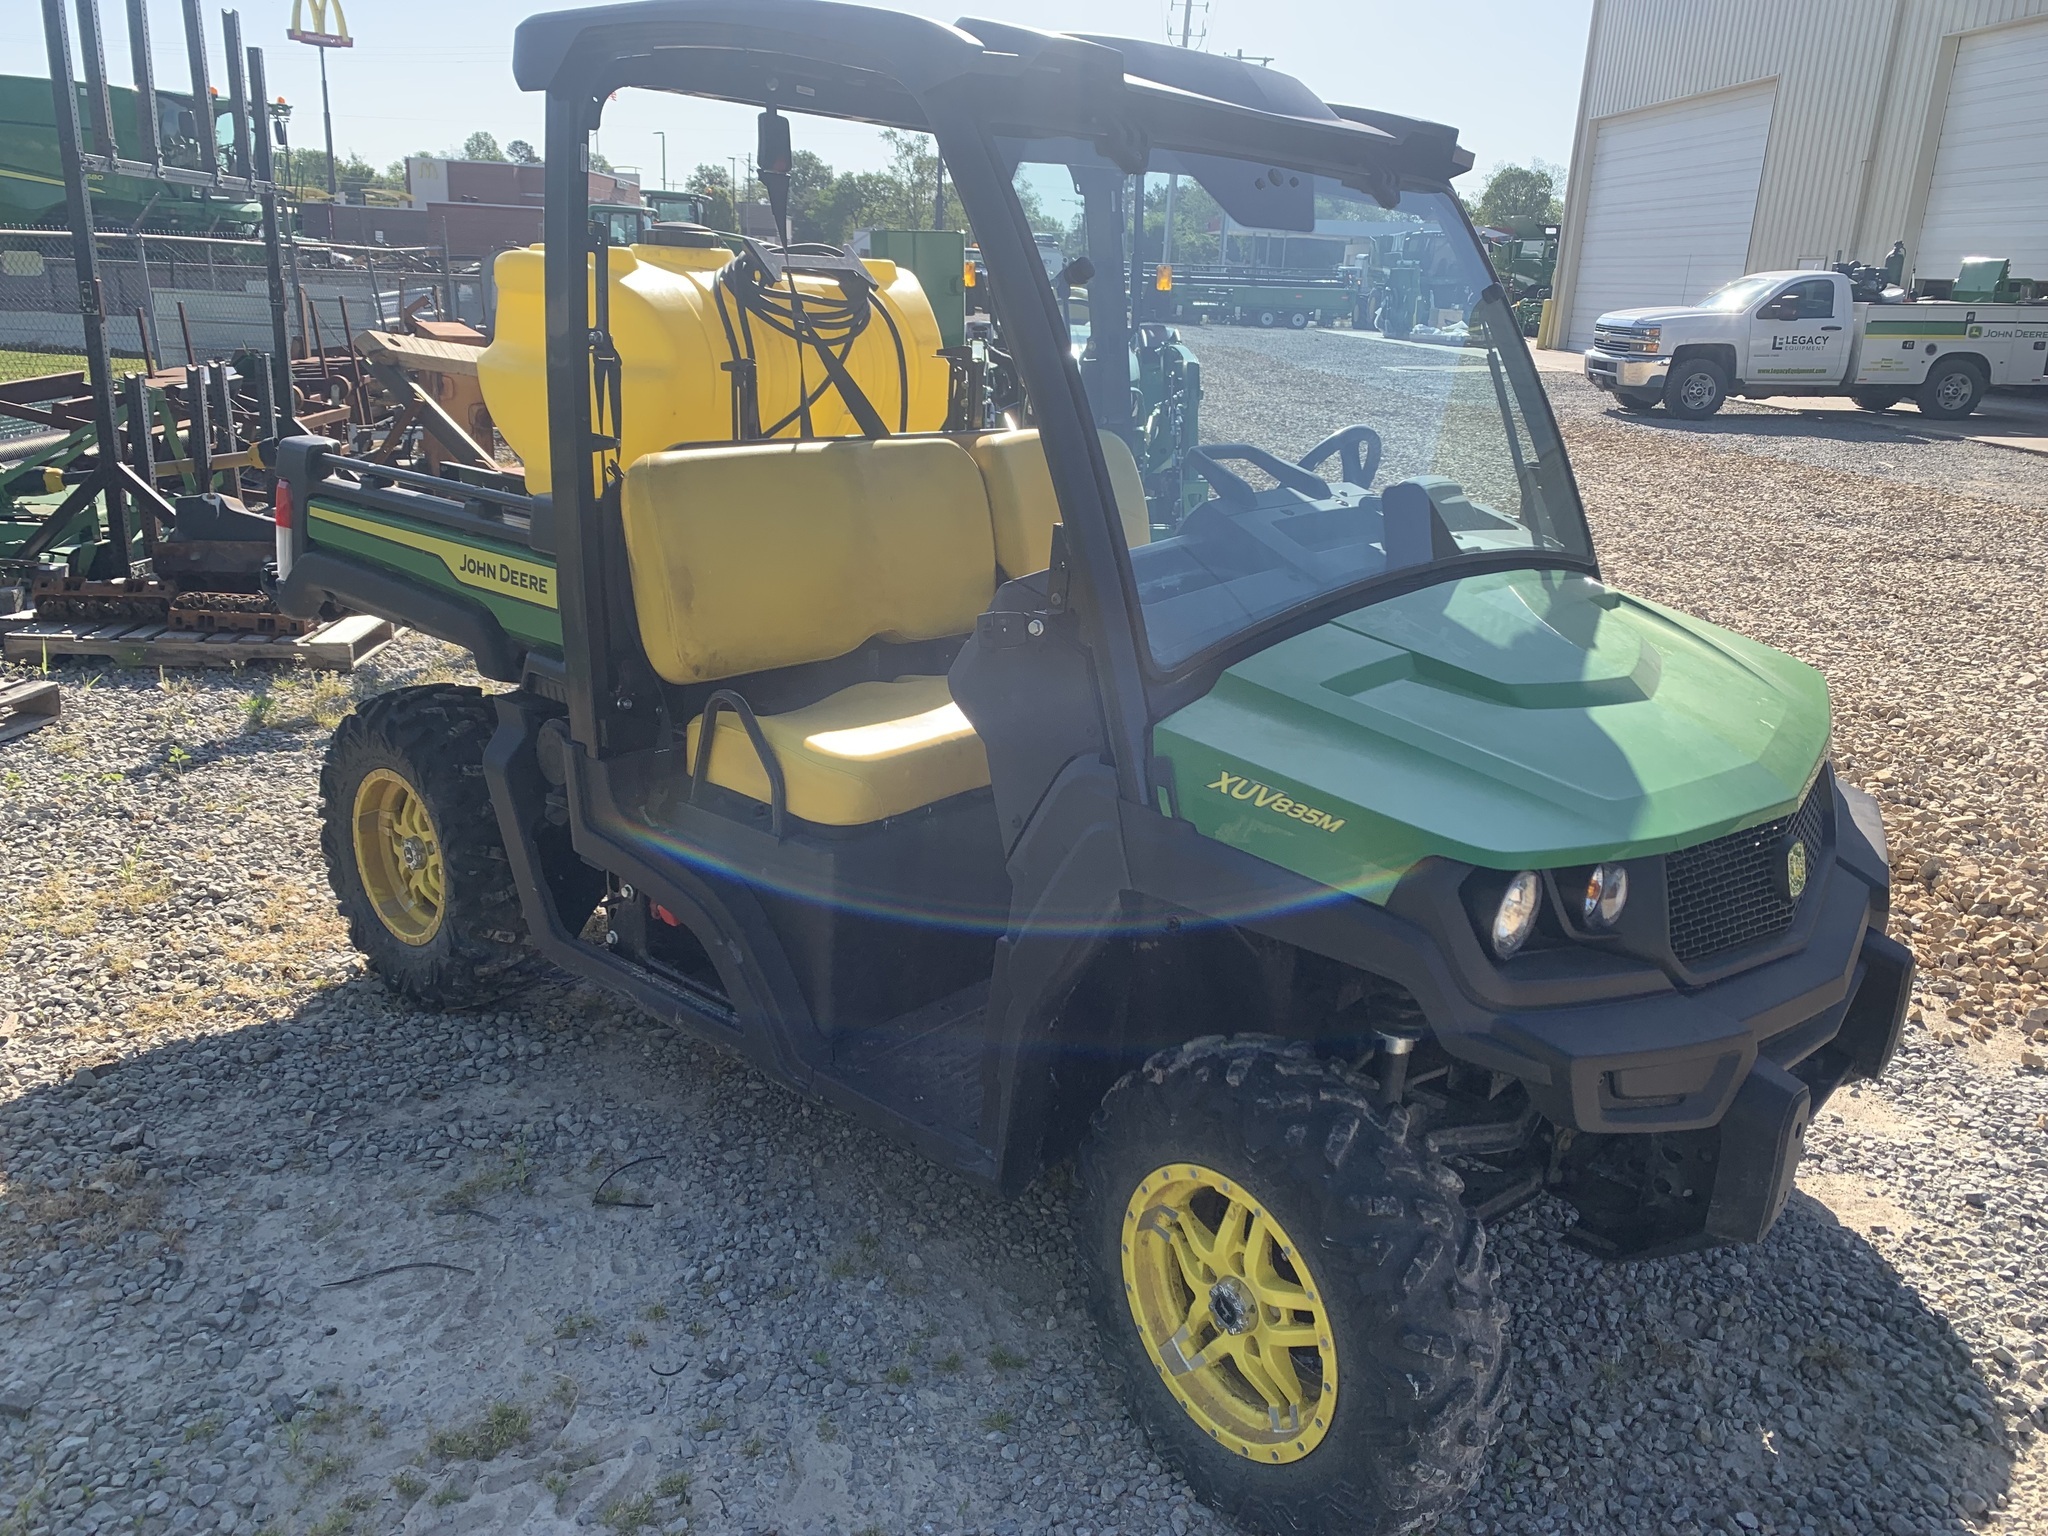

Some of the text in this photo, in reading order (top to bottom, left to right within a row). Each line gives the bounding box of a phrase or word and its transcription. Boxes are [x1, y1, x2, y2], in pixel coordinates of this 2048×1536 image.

[1785, 335, 1830, 345] LEGACY
[1983, 328, 2048, 339] JOHN DEERE
[459, 553, 548, 594] JOHN DEERE
[1205, 769, 1347, 833] XUV835M
